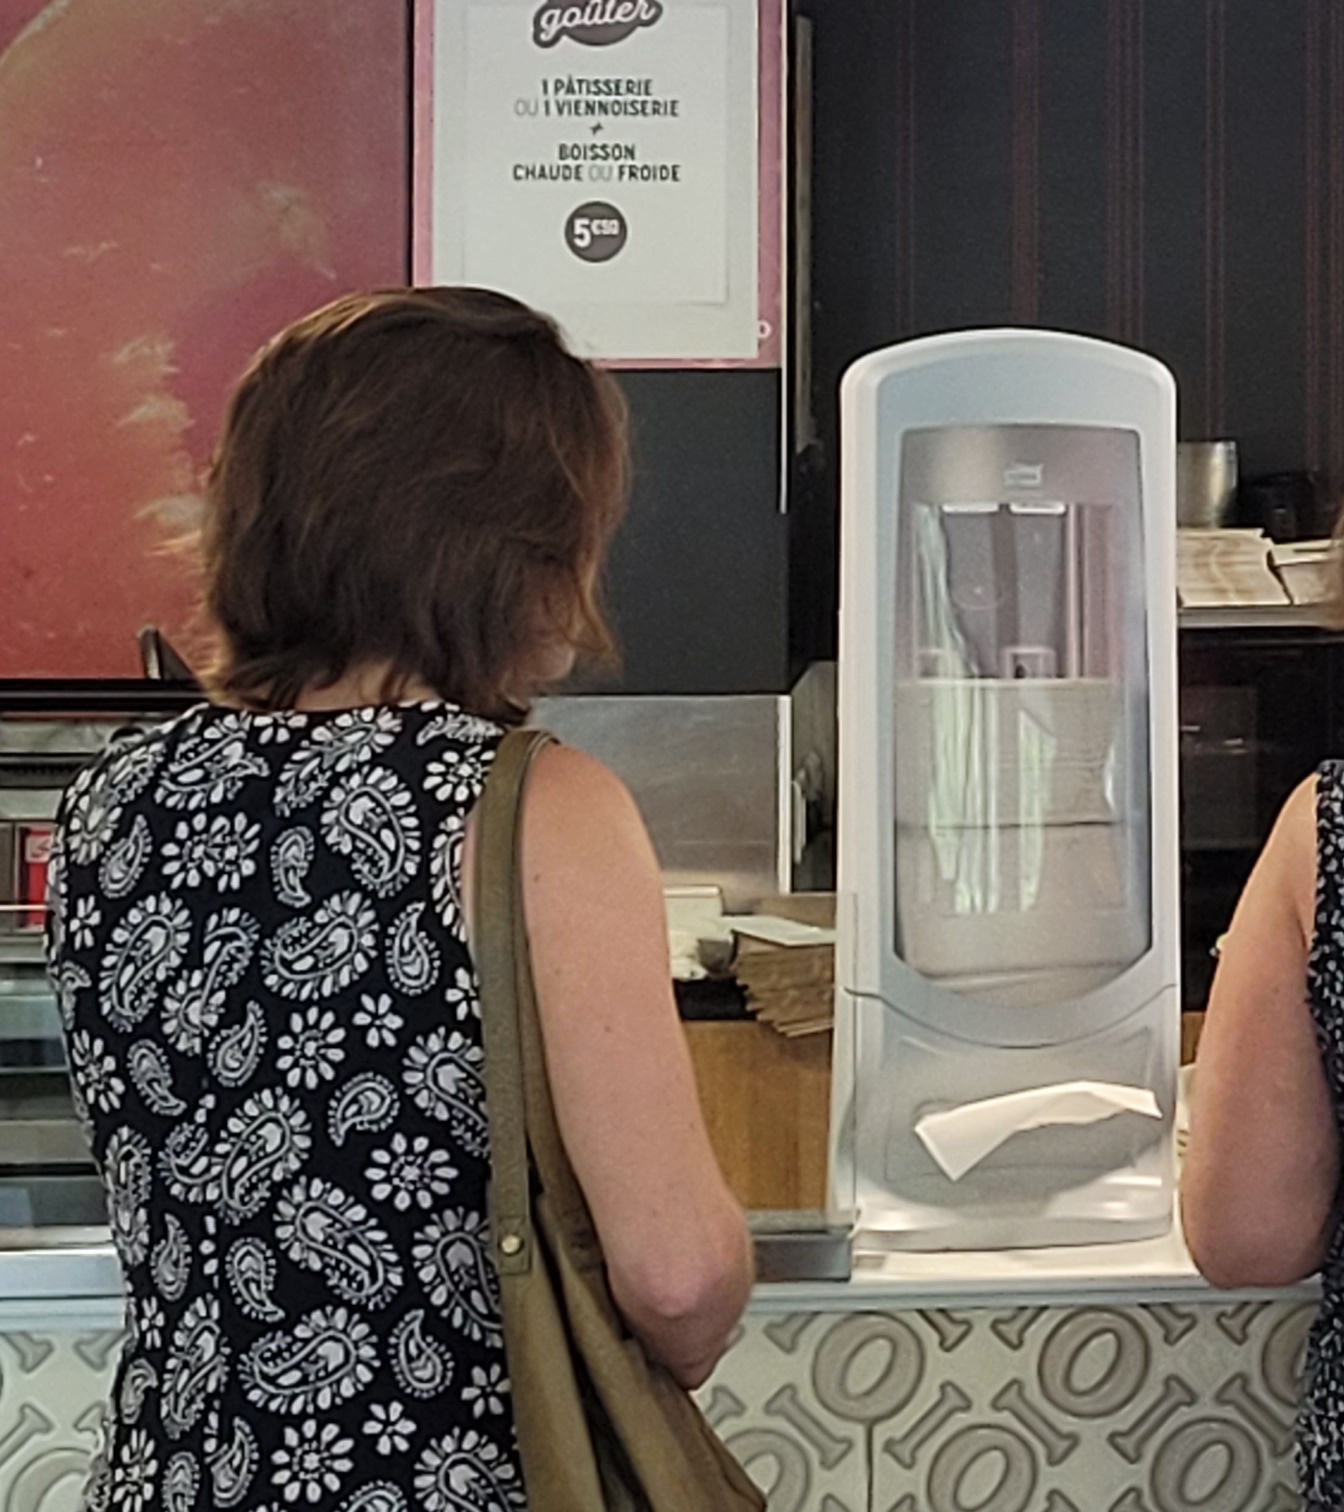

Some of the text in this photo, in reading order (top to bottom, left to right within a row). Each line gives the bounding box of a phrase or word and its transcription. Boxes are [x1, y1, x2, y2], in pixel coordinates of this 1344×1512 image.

[554, 74, 653, 96] PÂTISSERIE
[513, 98, 539, 117] OU
[555, 99, 680, 117] VIENNOISERIE
[558, 143, 636, 161] BOISSON
[512, 164, 681, 182] CHAUDE OU FROIDE
